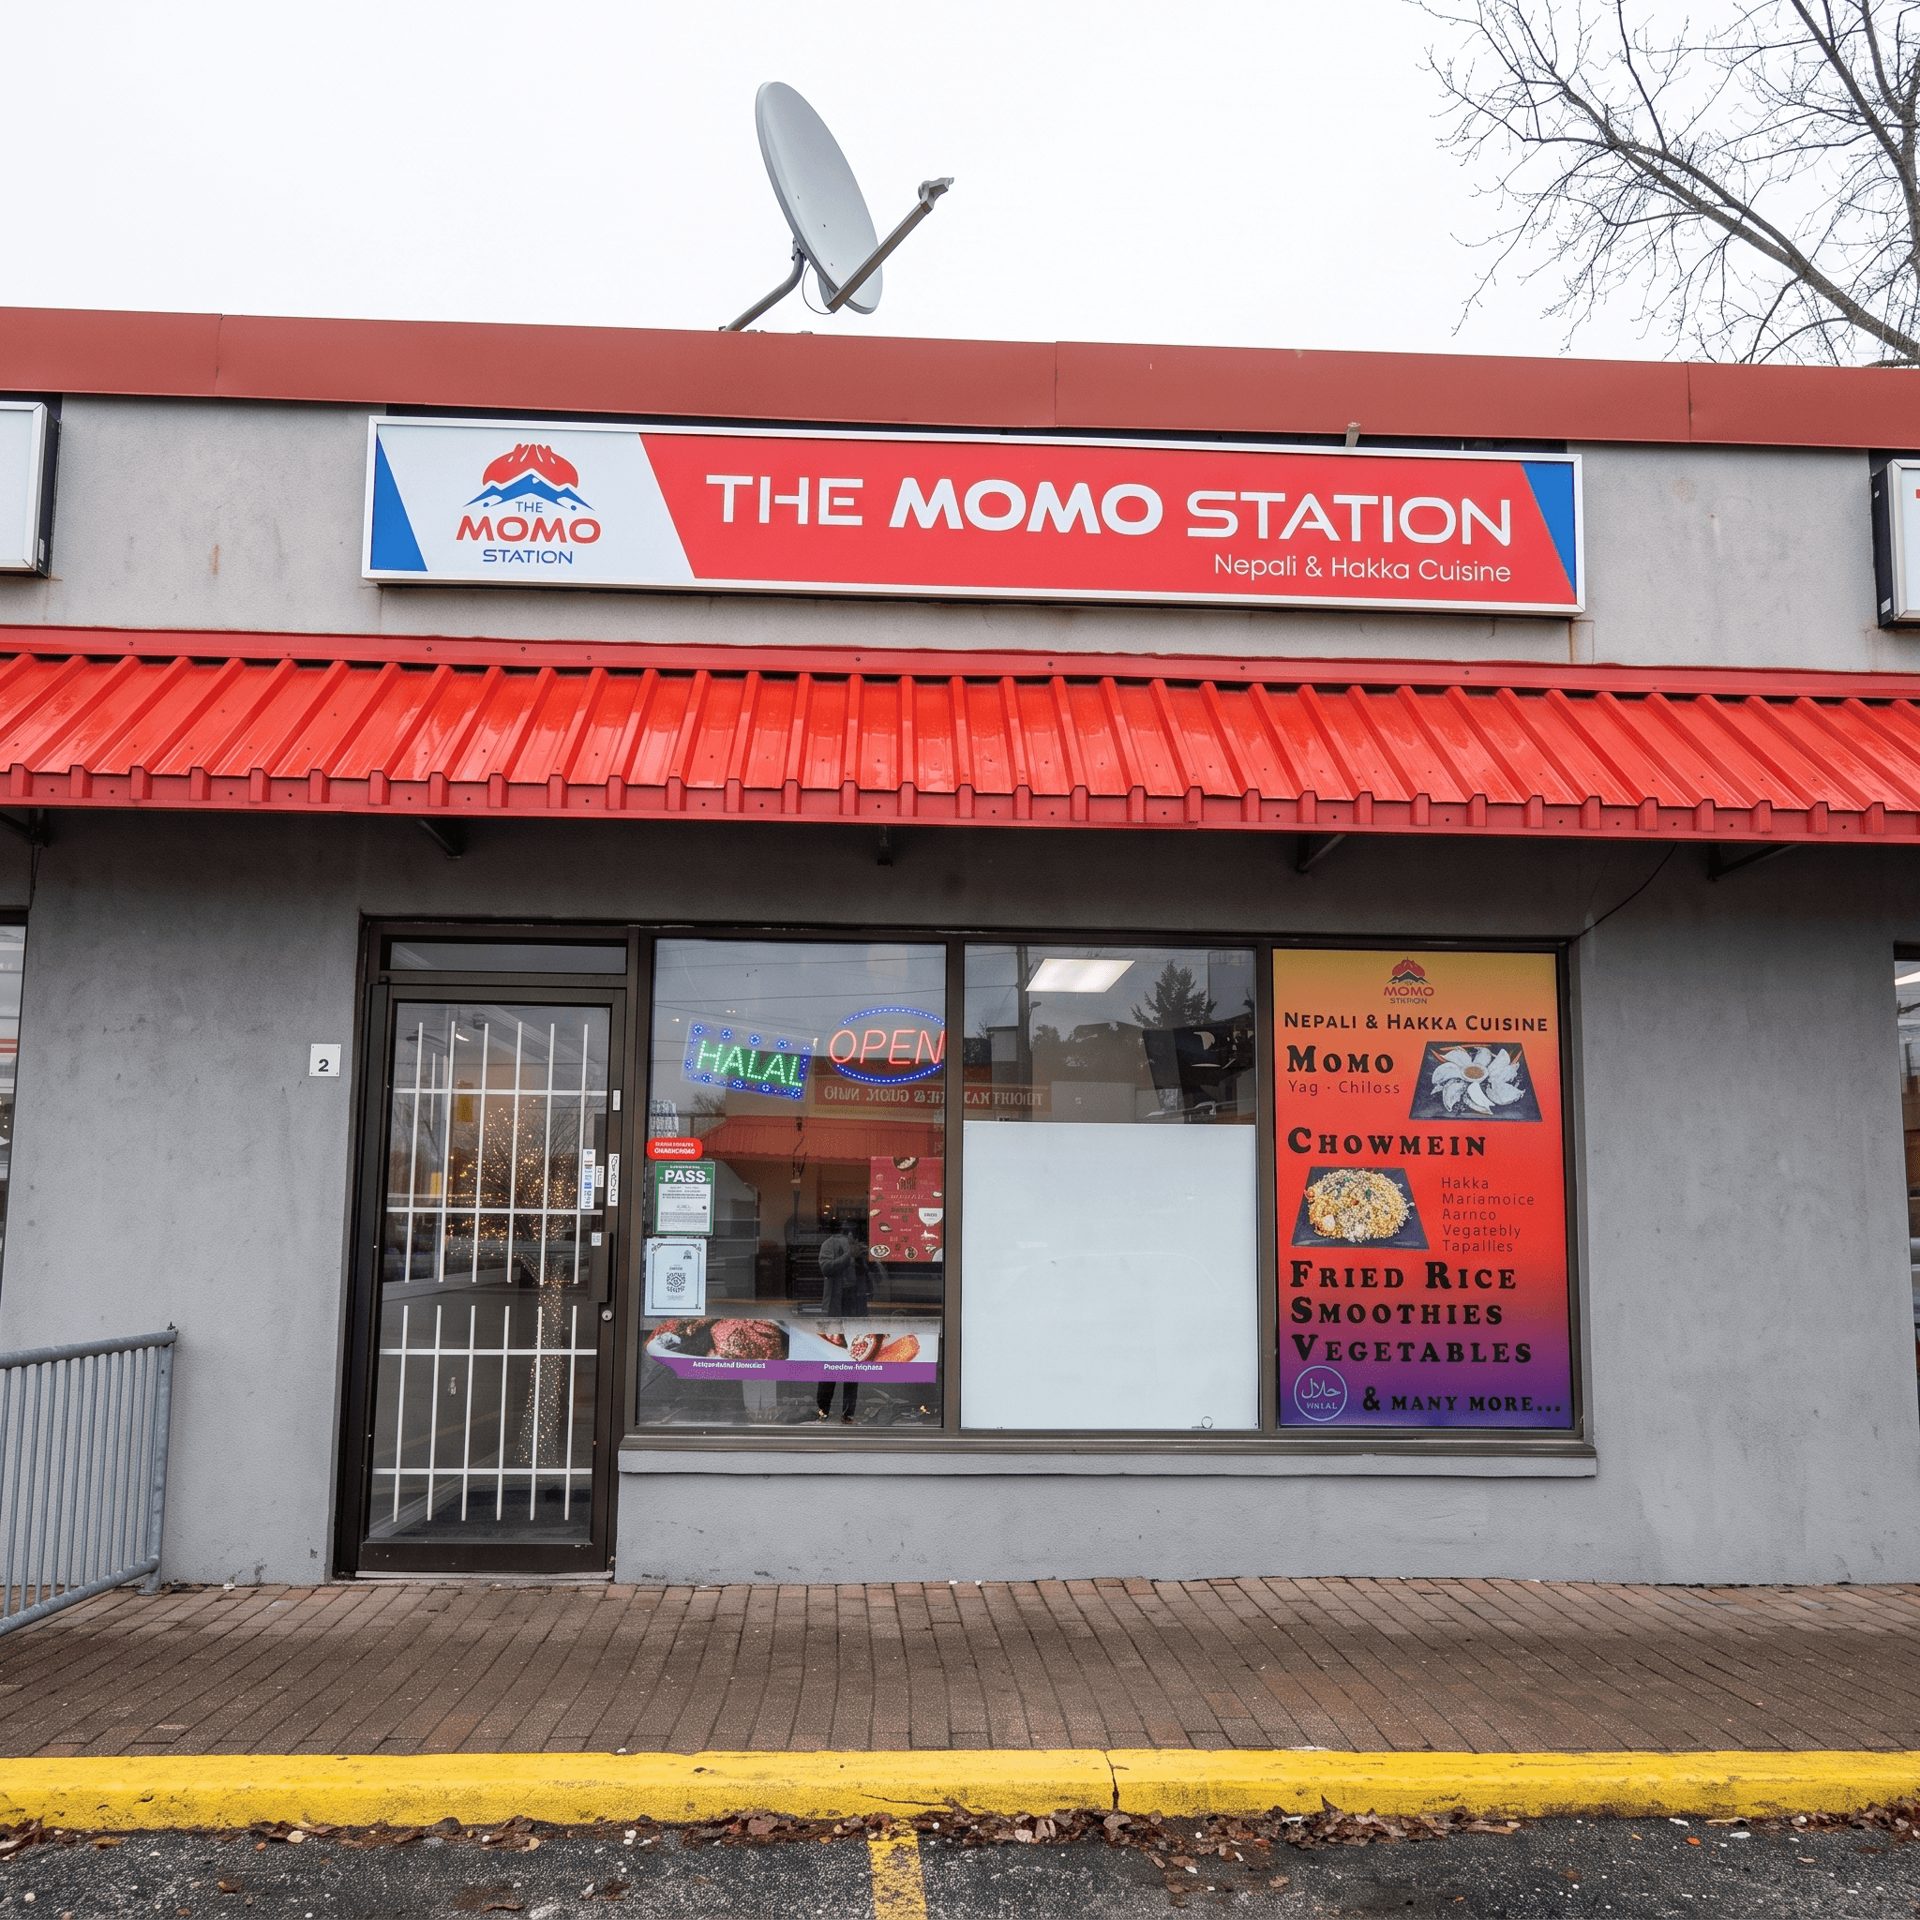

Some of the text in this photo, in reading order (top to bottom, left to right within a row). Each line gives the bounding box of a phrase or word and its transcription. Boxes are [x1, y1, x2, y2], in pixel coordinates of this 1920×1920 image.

[515, 501, 544, 513] THE
[706, 474, 1511, 547] THE MOMO STATION
[456, 515, 601, 544] MOMO
[482, 549, 573, 564] STATION
[1214, 553, 1512, 583] Nepali & Hakka Cuisine
[1384, 986, 1435, 997] MOMO
[1365, 1014, 1378, 1029] &
[829, 1029, 945, 1065] OPEN
[319, 1059, 328, 1072] 2
[697, 1040, 802, 1087] HALAL
[1288, 1079, 1319, 1096] Yag
[664, 1169, 706, 1183] PASS
[1441, 1176, 1489, 1189] Hakka
[1362, 1386, 1381, 1412] &
